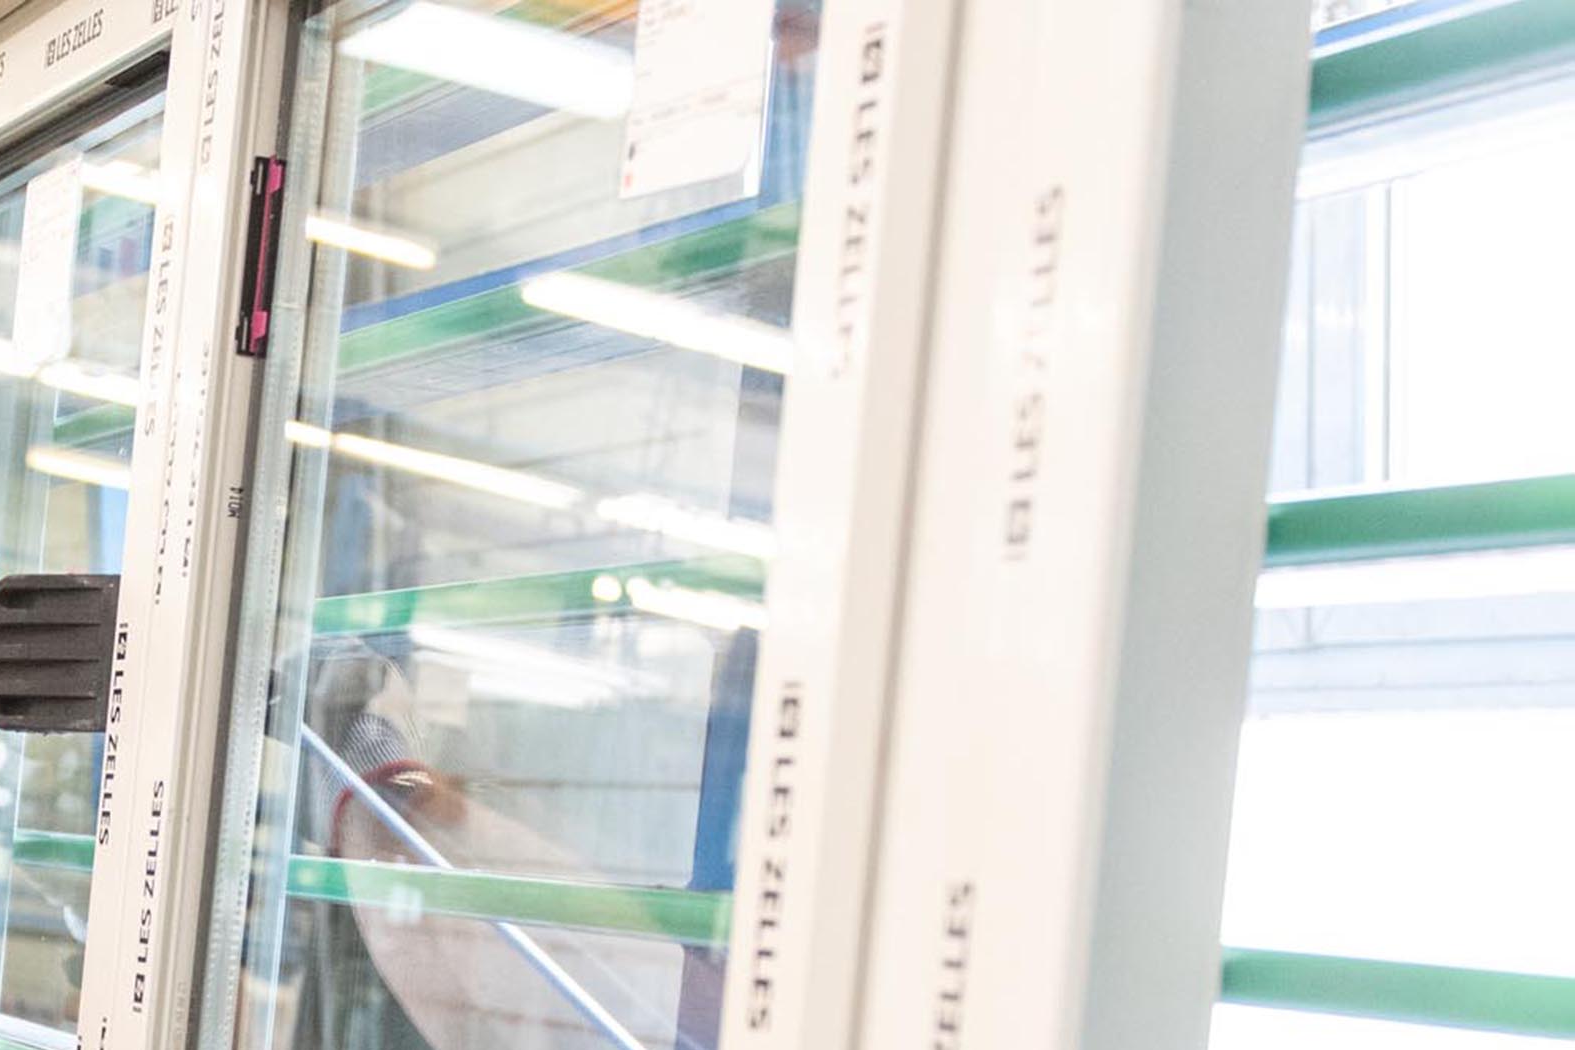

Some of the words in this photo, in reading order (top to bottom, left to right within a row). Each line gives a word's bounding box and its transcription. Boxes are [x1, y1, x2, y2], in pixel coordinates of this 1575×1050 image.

[56, 28, 73, 61] LES
[72, 8, 104, 51] ZELLES
[110, 670, 123, 723] LES
[99, 734, 119, 845] ZELLES
[768, 755, 795, 839] LES
[144, 780, 164, 898] ZELLES
[137, 908, 152, 964] LES
[748, 856, 786, 1034] ZELLES
